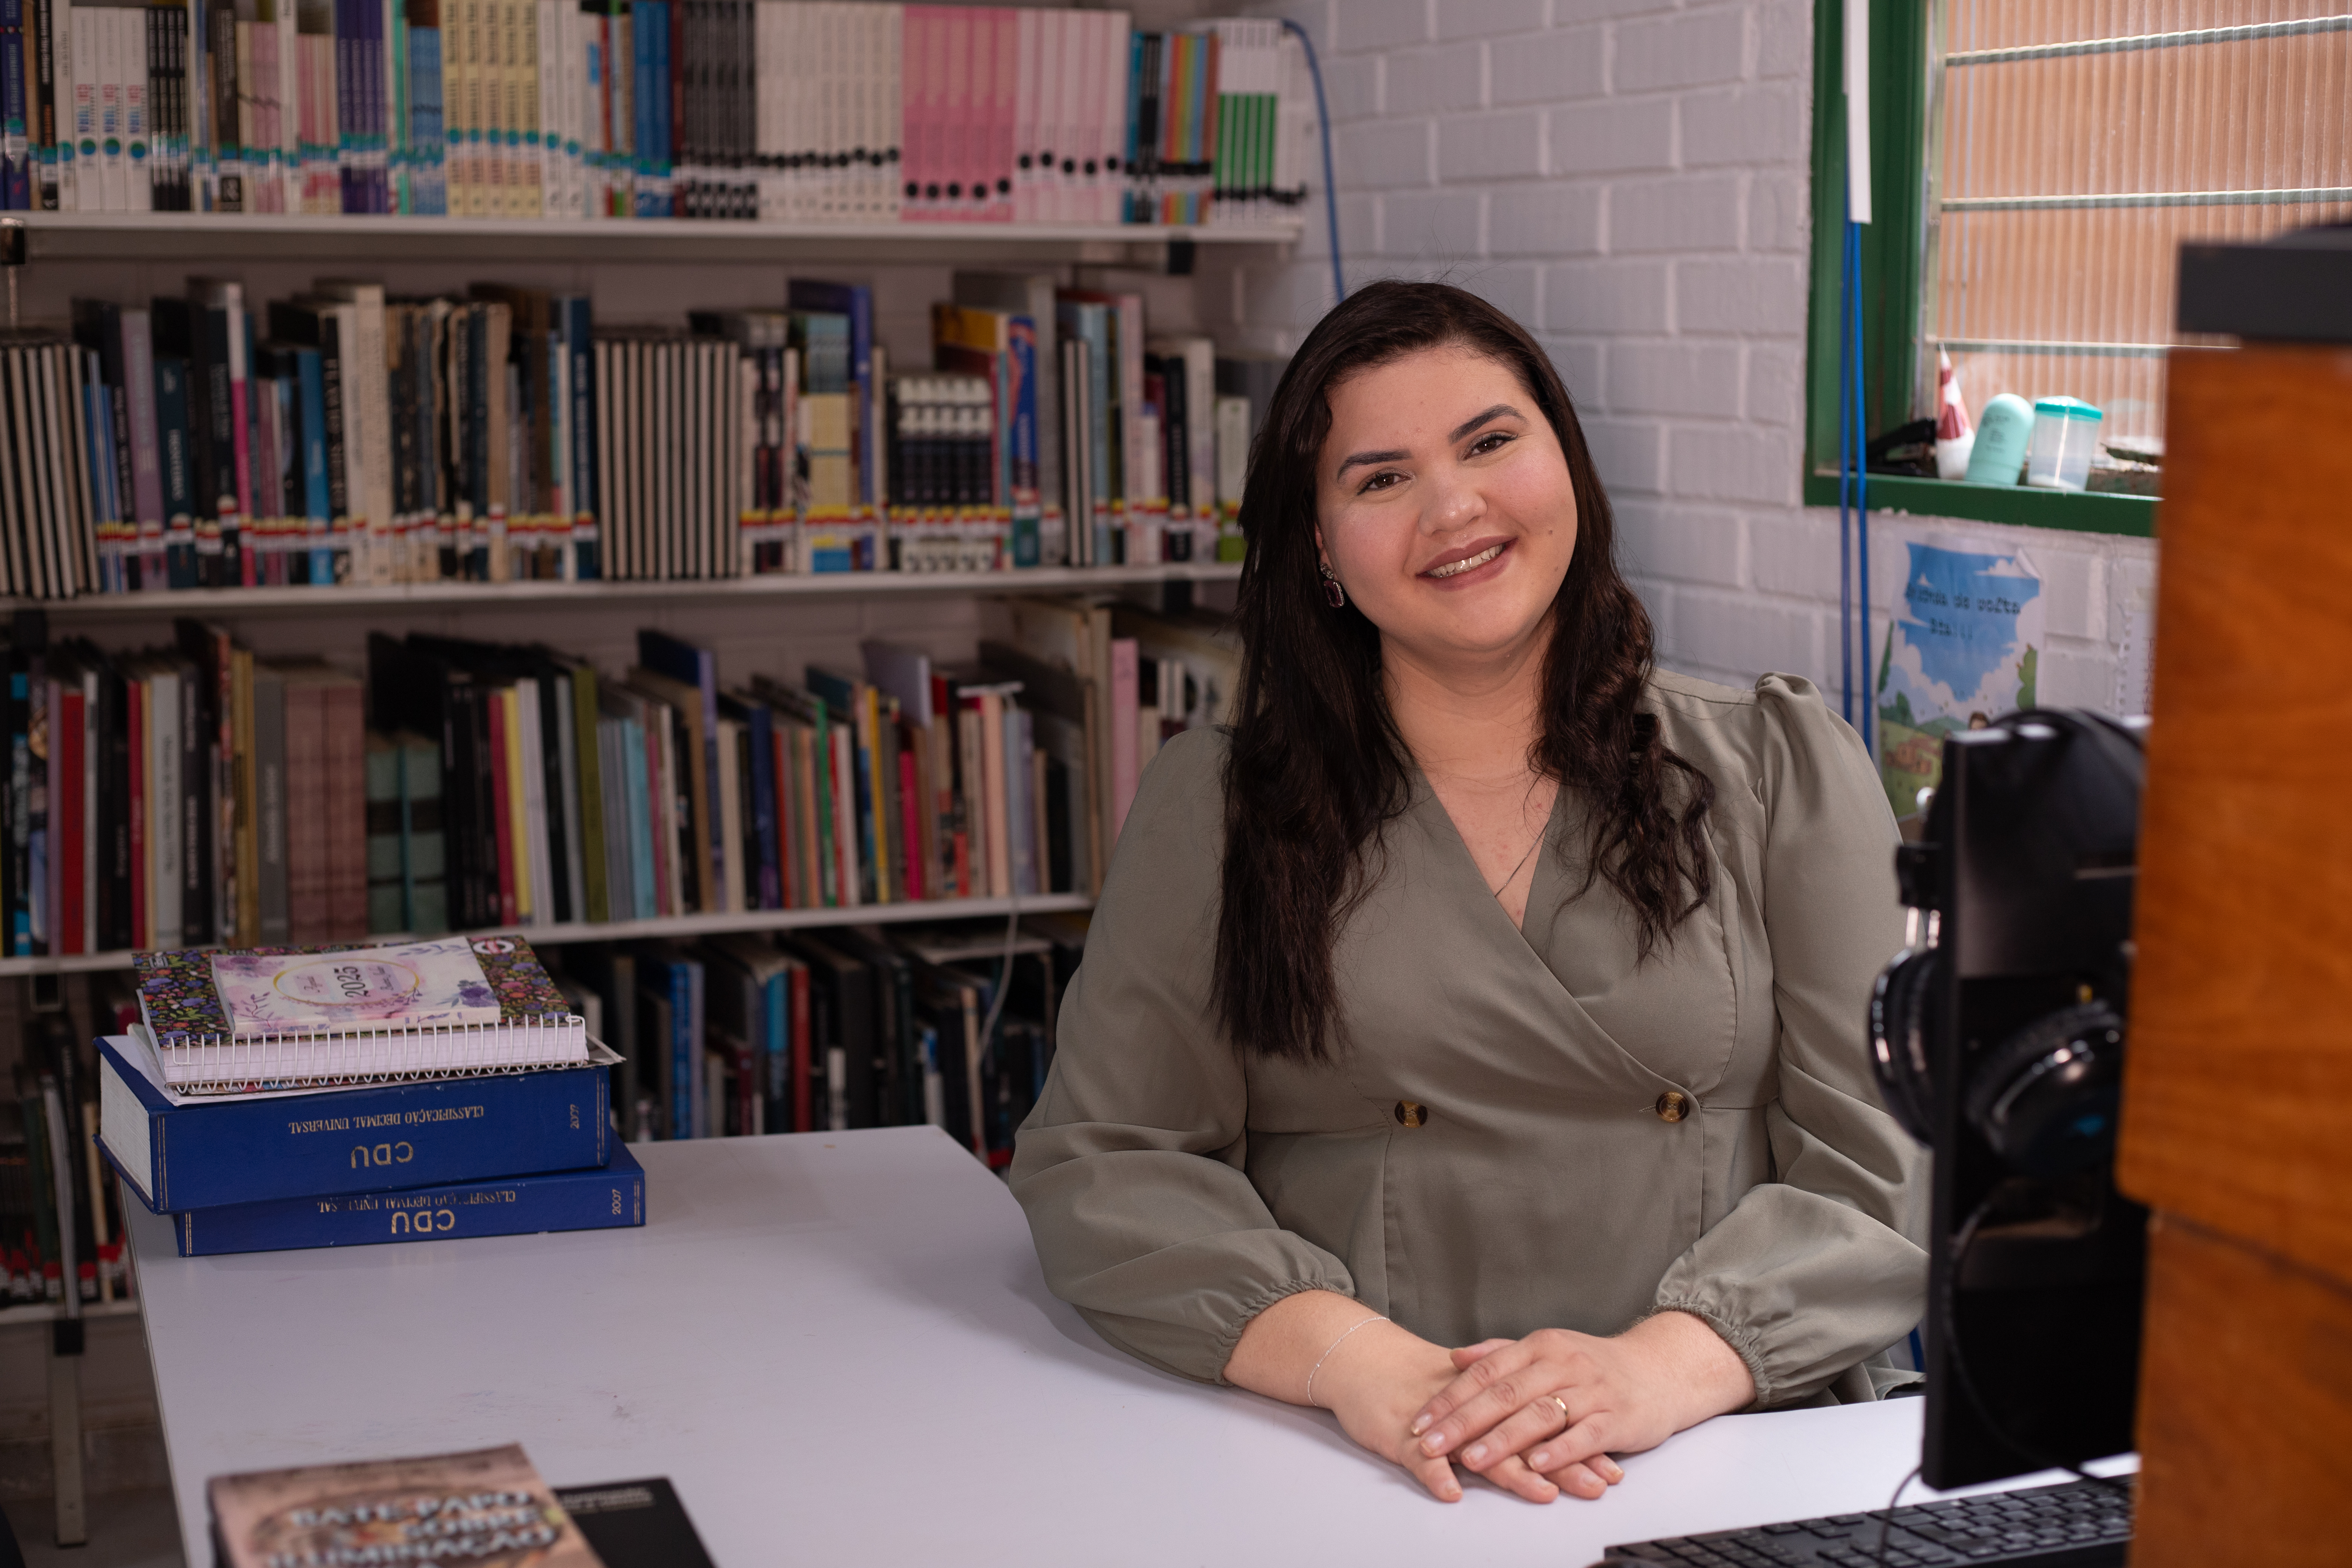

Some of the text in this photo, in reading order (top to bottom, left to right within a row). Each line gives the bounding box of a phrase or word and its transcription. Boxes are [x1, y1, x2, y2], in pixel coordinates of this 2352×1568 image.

[1977, 596, 2020, 614] volta
[333, 966, 371, 998] 2025
[288, 1105, 484, 1134] CLASSIFICAÇÃO DECIMAL UNIVERSAL
[570, 1104, 579, 1129] 2007
[351, 1141, 414, 1169] CDU
[385, 1196, 430, 1209] DECIMAL
[612, 1188, 622, 1215] 2007
[391, 1209, 455, 1234] CDU
[291, 1502, 401, 1528] BATE
[417, 1490, 534, 1517] PAPO
[402, 1509, 541, 1540] SOBRE
